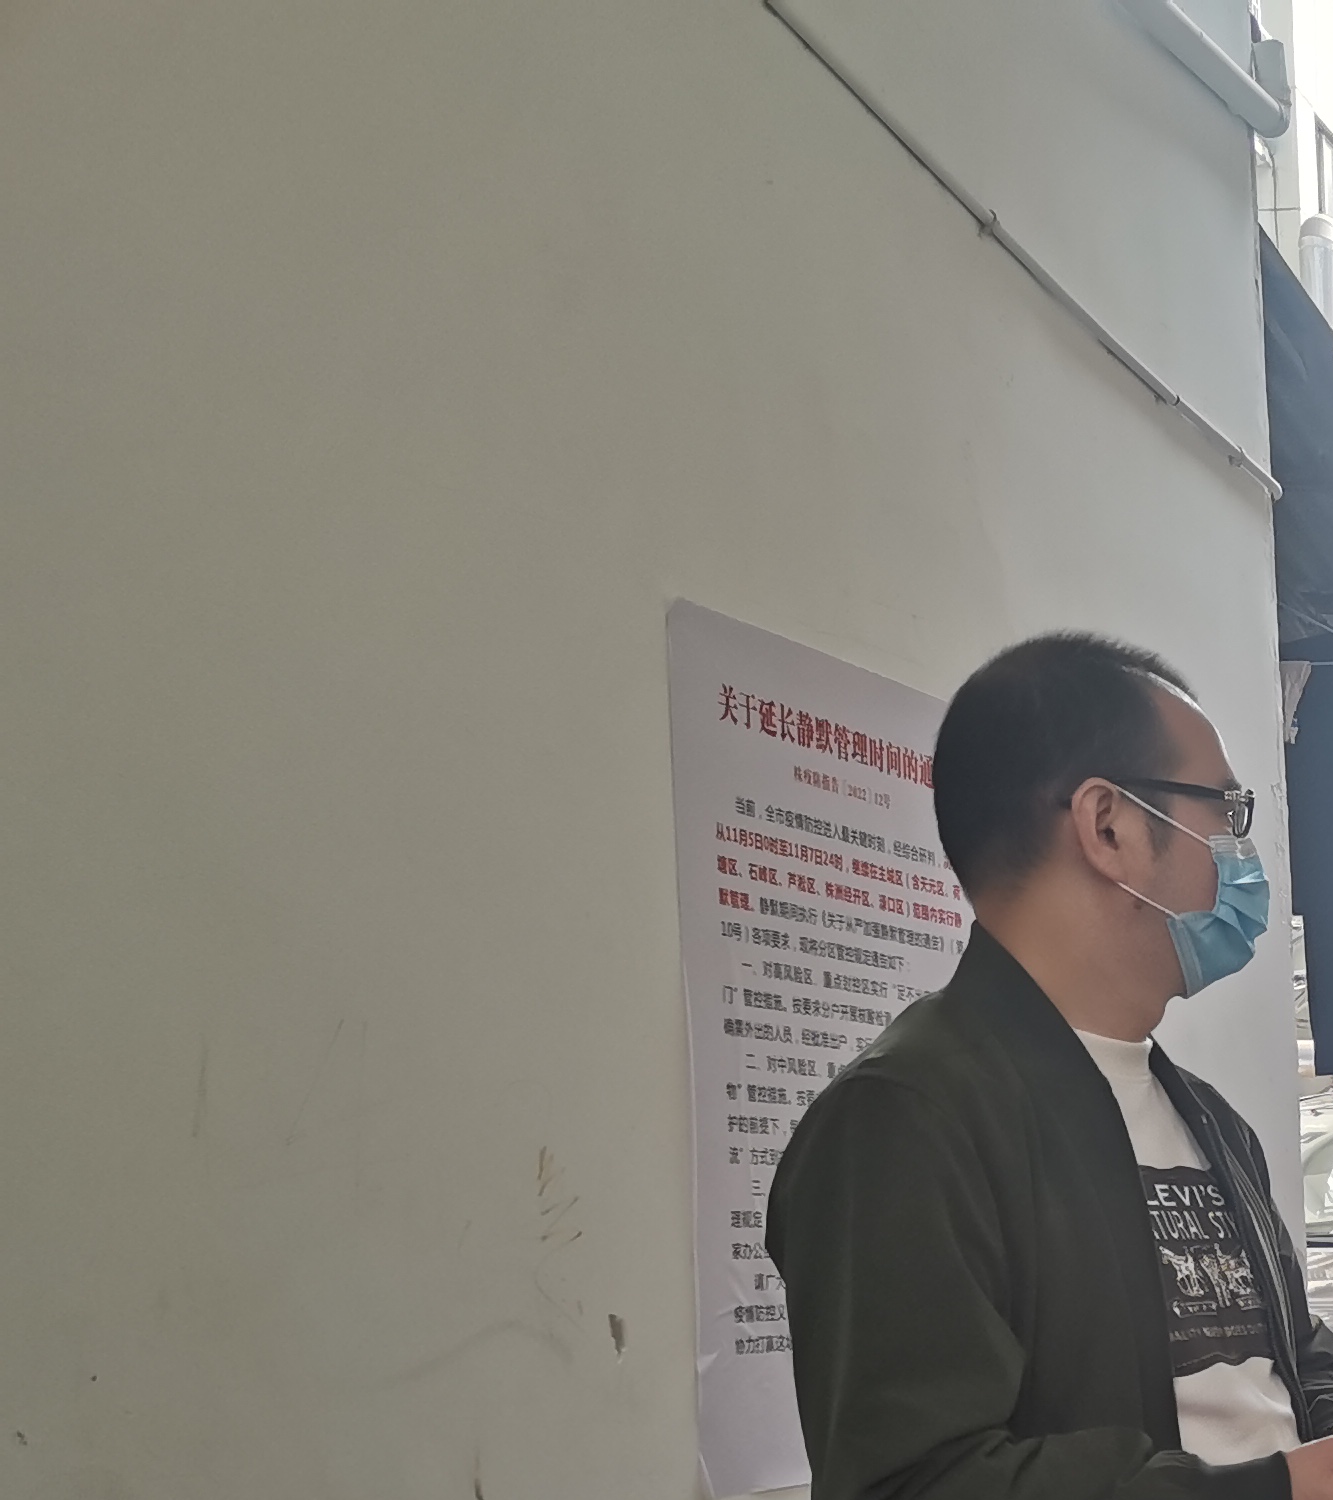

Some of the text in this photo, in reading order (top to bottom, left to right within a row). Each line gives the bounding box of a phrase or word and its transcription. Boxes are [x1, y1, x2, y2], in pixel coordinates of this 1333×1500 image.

[718, 683, 936, 789] 关于延长静默管理时间的通
[1149, 1210, 1211, 1240] TURAL
